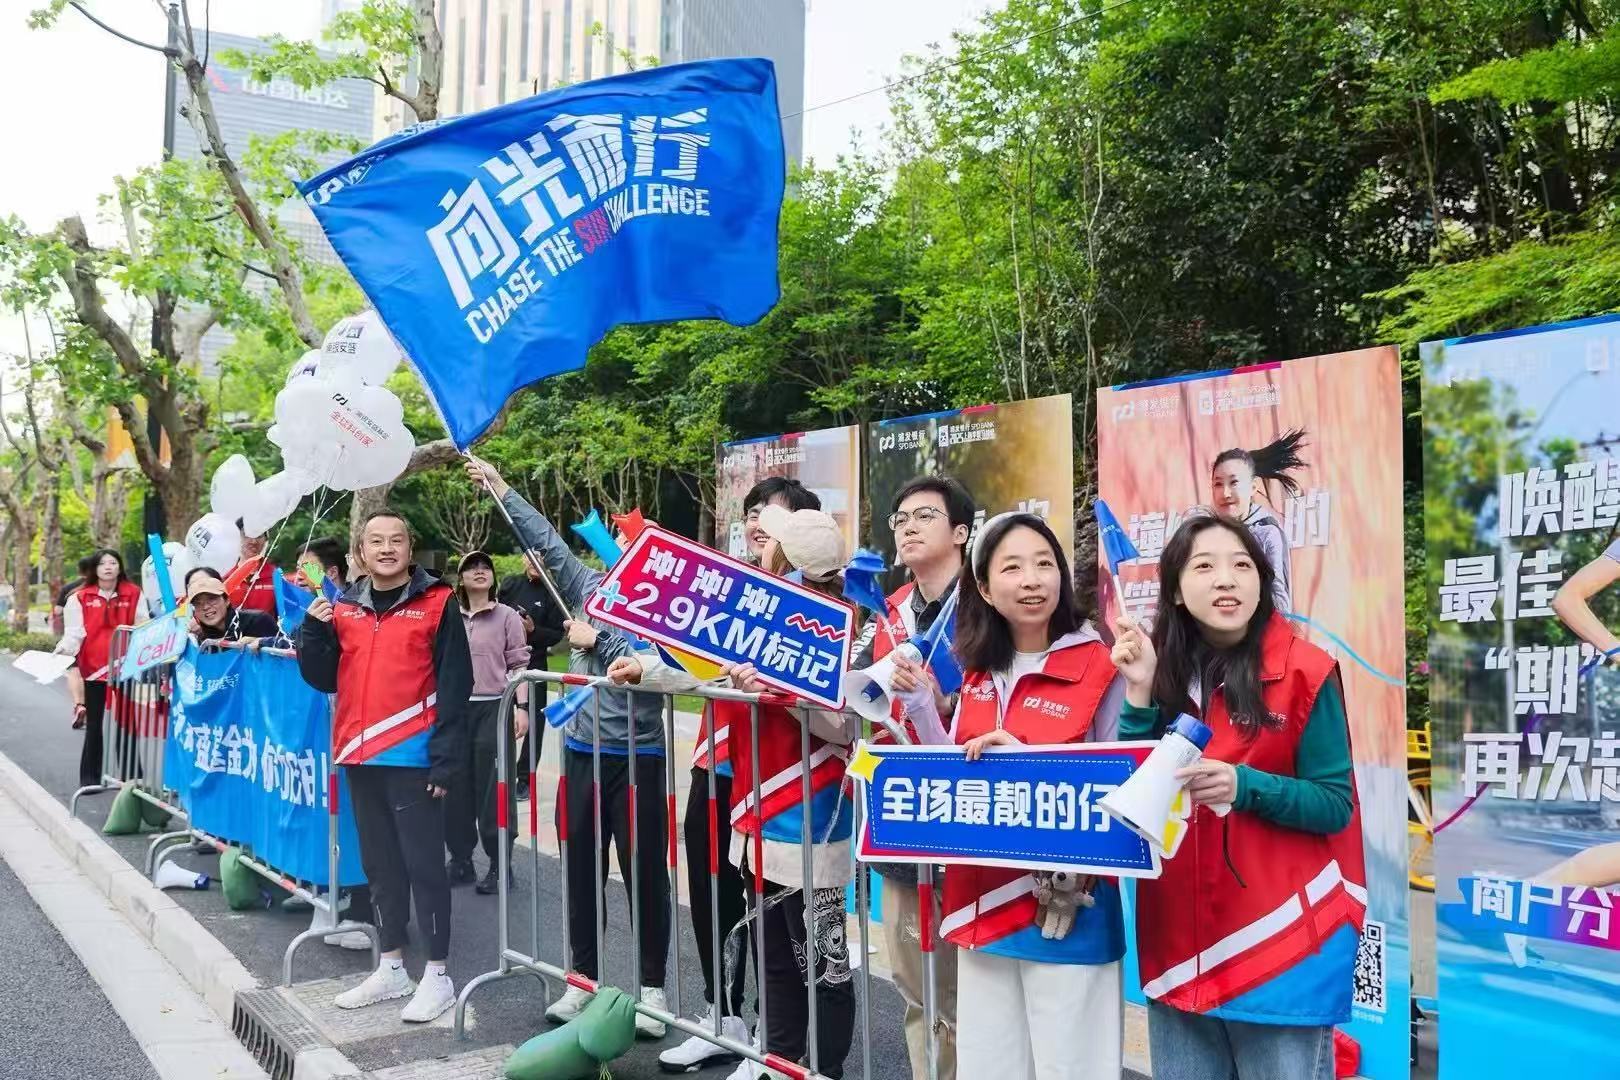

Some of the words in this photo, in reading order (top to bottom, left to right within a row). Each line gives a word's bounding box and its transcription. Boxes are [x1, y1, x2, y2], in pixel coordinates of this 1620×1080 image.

[426, 108, 710, 309] 向光而行
[466, 259, 544, 344] CHASE
[533, 226, 584, 277] THE
[573, 207, 612, 254] SUN
[603, 183, 711, 234] CHALLENGE
[1500, 459, 1620, 538] 唤醒
[1439, 549, 1563, 623] 最佳
[626, 582, 840, 689] 2.9KM标记
[881, 777, 1119, 832] 全场最靓的仔
[1471, 871, 1620, 940] 商户分
